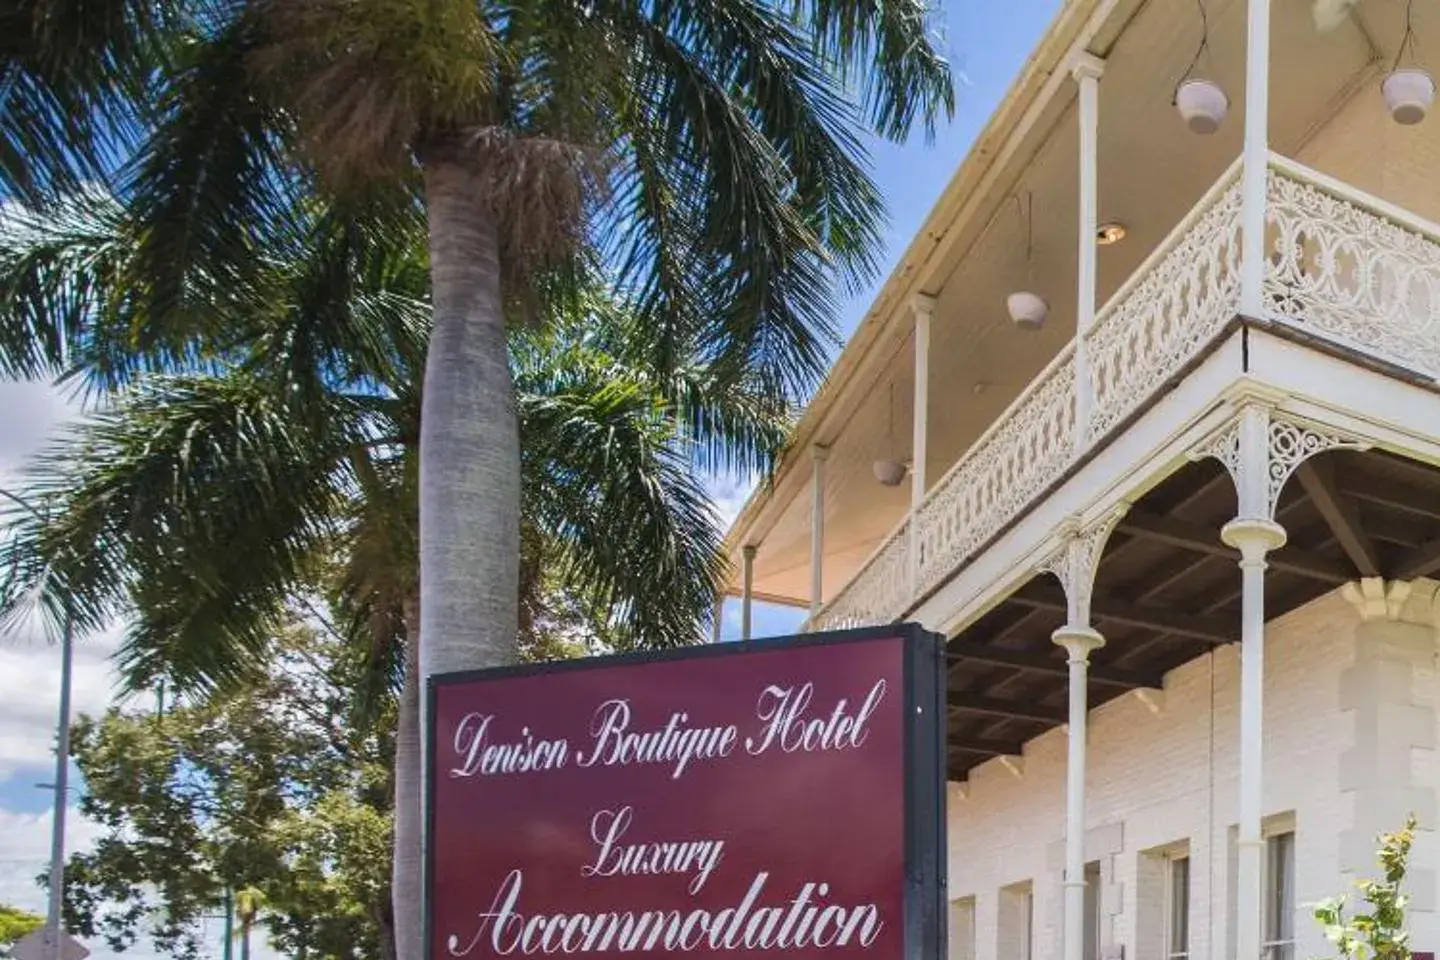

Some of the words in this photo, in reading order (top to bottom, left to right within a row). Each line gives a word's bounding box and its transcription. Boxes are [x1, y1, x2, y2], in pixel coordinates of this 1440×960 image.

[451, 712, 568, 777] Denison
[577, 699, 737, 778] Boutique
[746, 679, 887, 755] Hotel
[581, 806, 724, 894] Luxury
[449, 869, 884, 956] Accommodation
